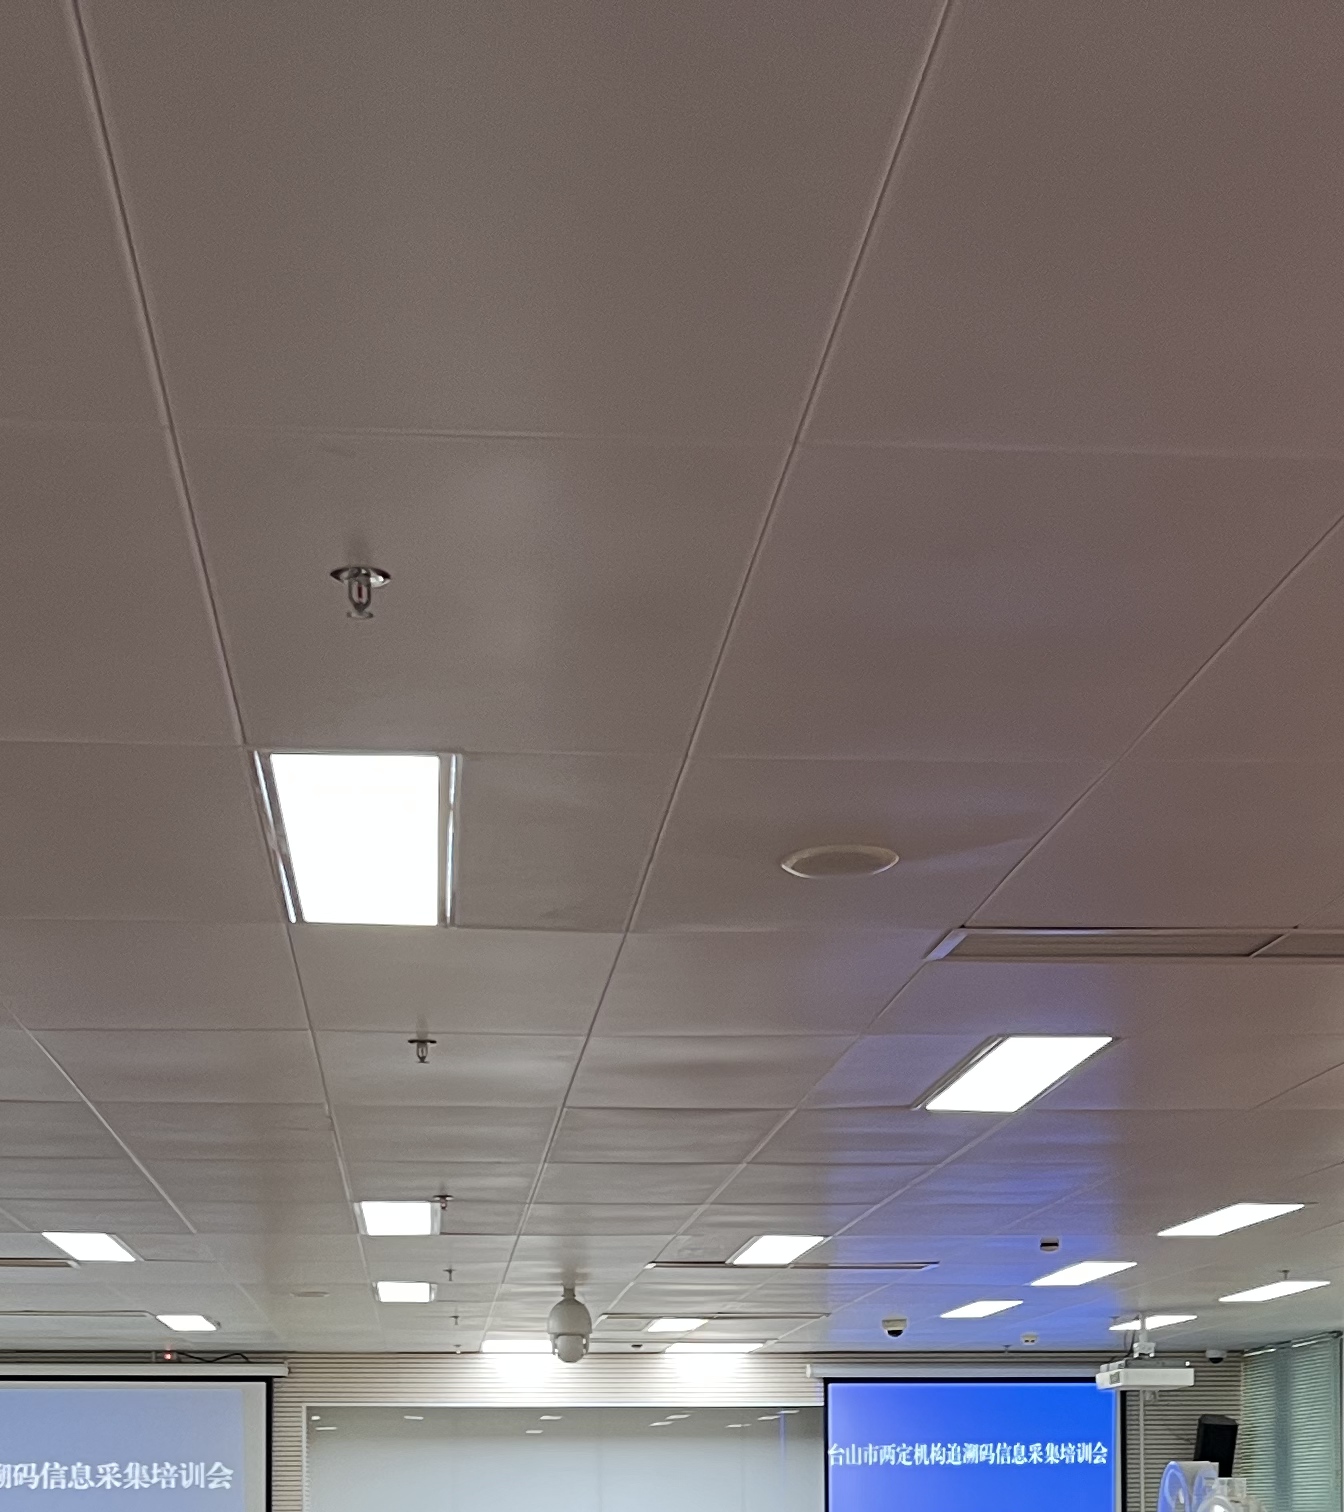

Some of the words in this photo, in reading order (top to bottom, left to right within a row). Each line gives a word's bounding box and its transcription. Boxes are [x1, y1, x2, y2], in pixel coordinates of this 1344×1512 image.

[828, 1442, 1108, 1466] 台山市两定机构追溯码信息采集培训会
